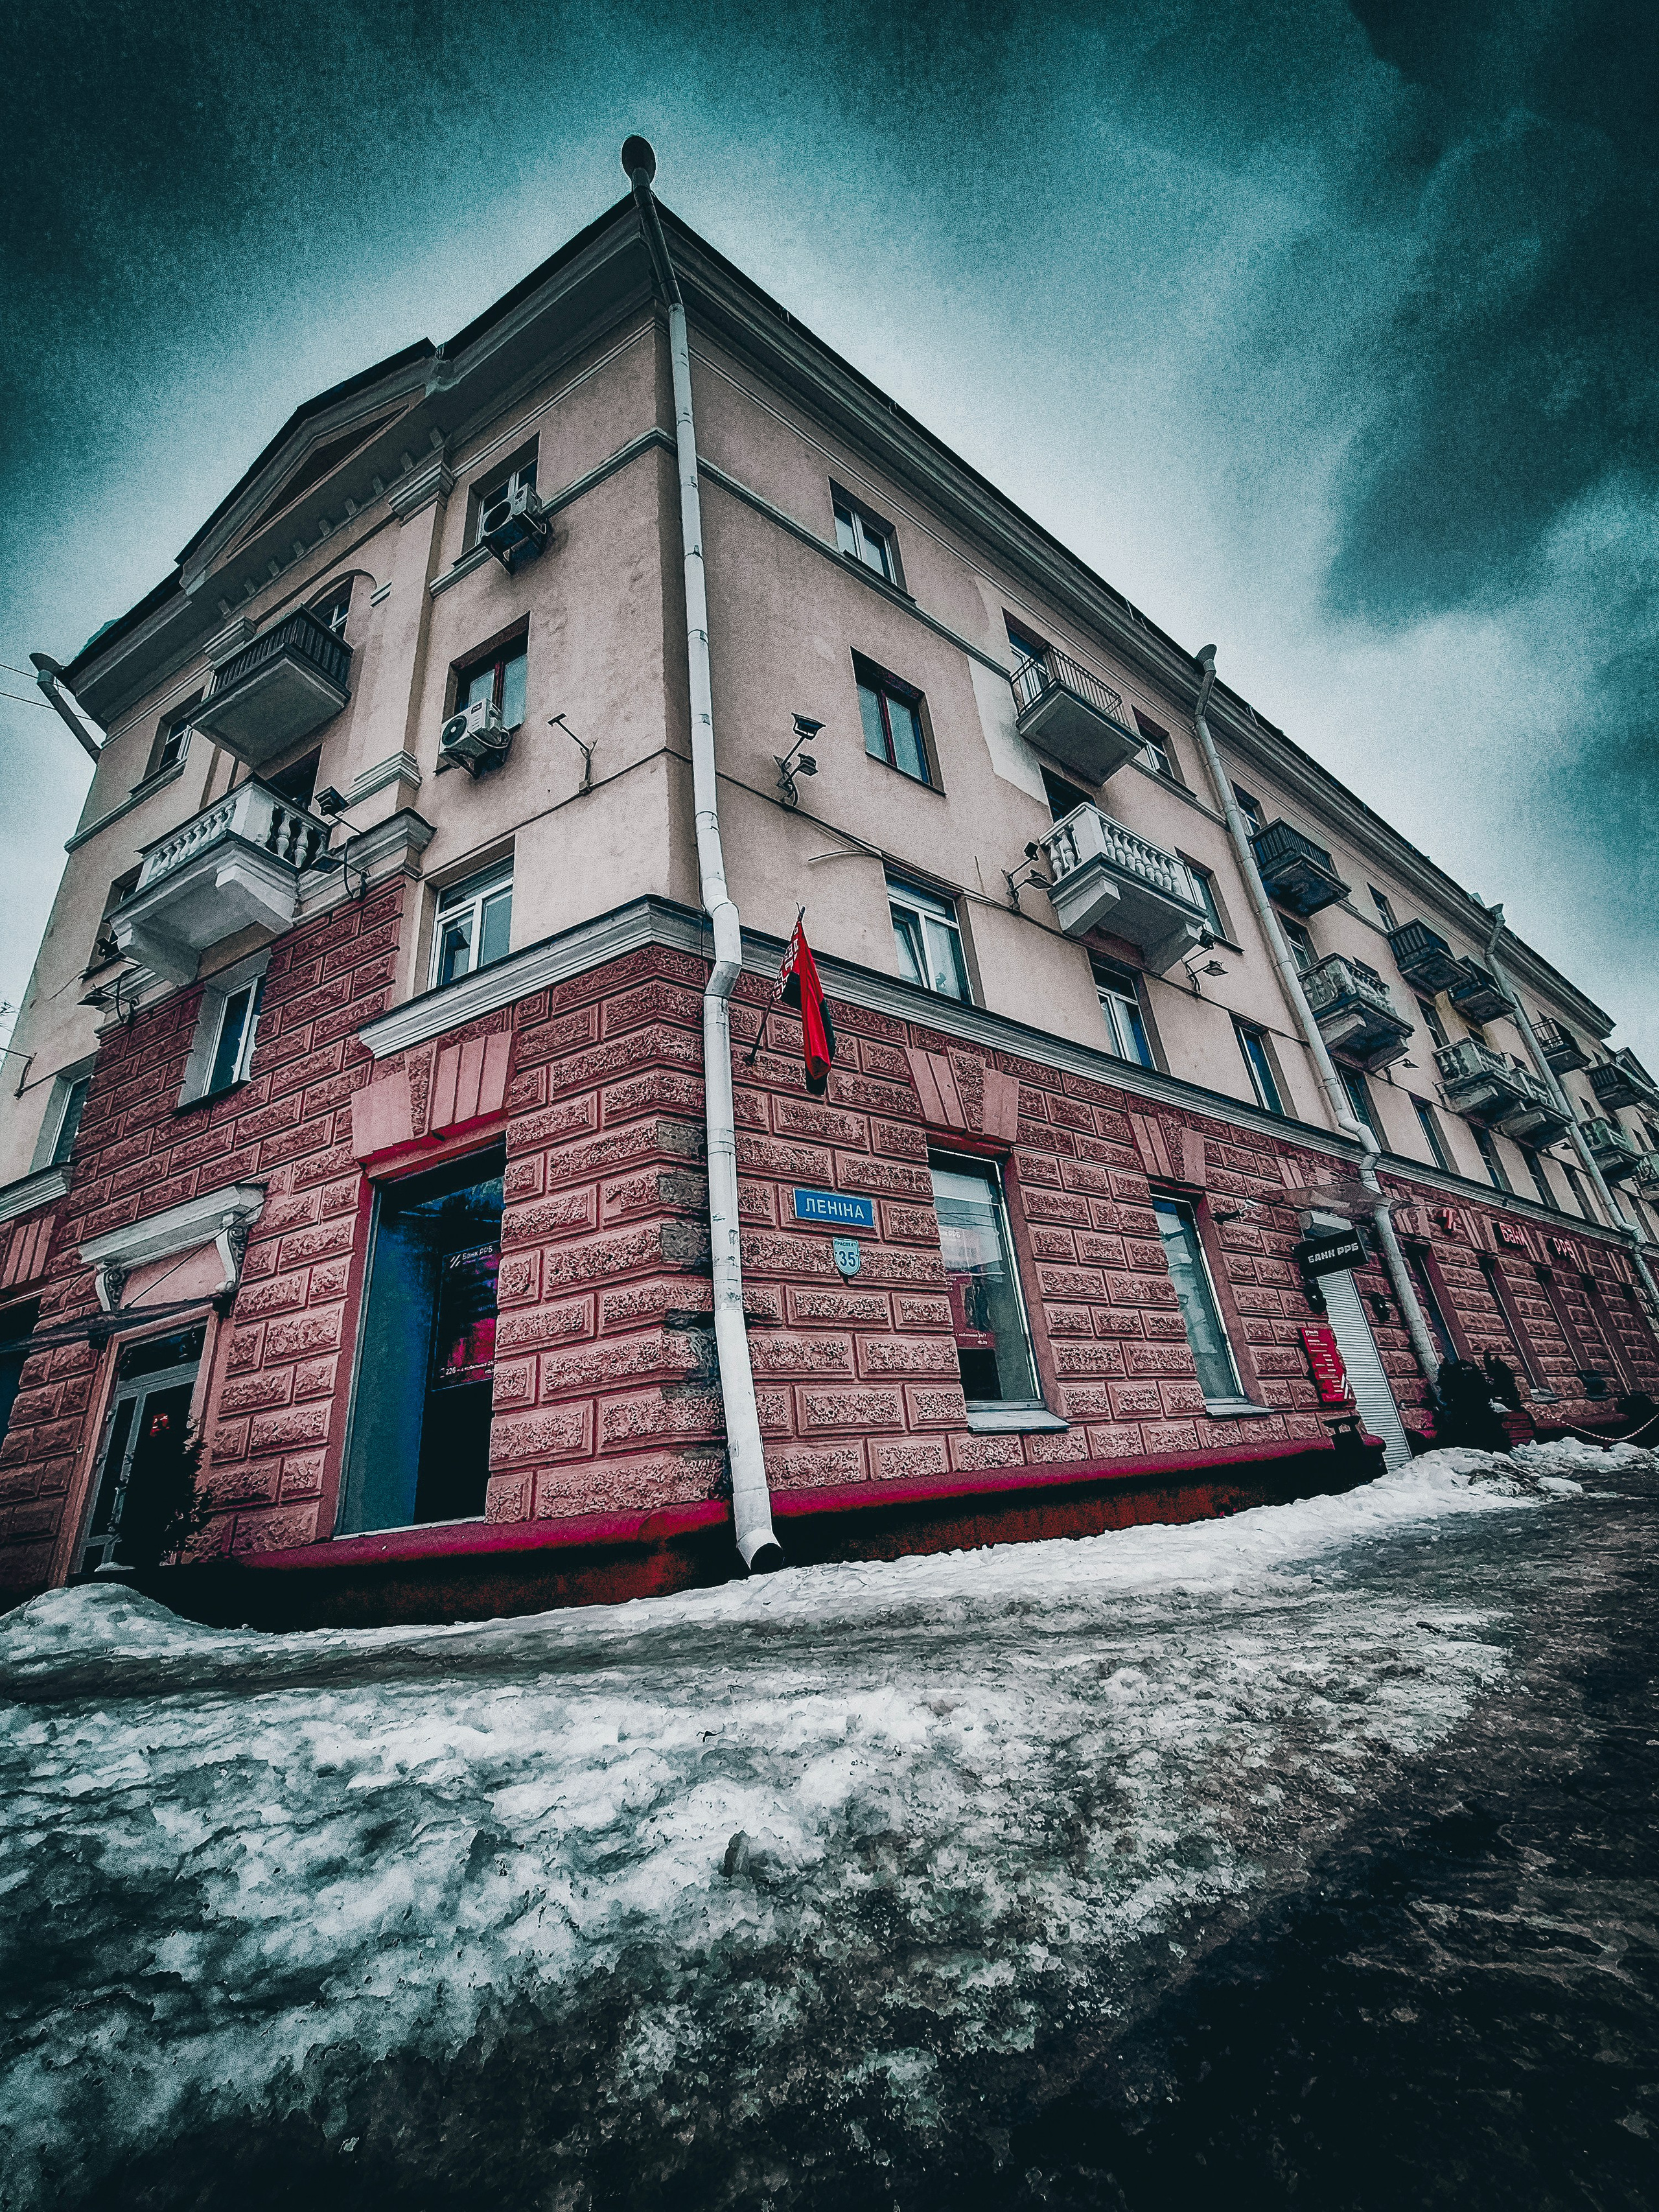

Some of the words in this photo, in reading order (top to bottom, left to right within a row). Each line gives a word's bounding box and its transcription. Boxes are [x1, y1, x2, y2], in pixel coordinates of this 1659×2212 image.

[806, 1198, 864, 1219] ЛЕНІНА
[479, 1245, 493, 1255] РРБ
[1337, 1242, 1359, 1255] РРБ
[839, 1250, 856, 1267] 35
